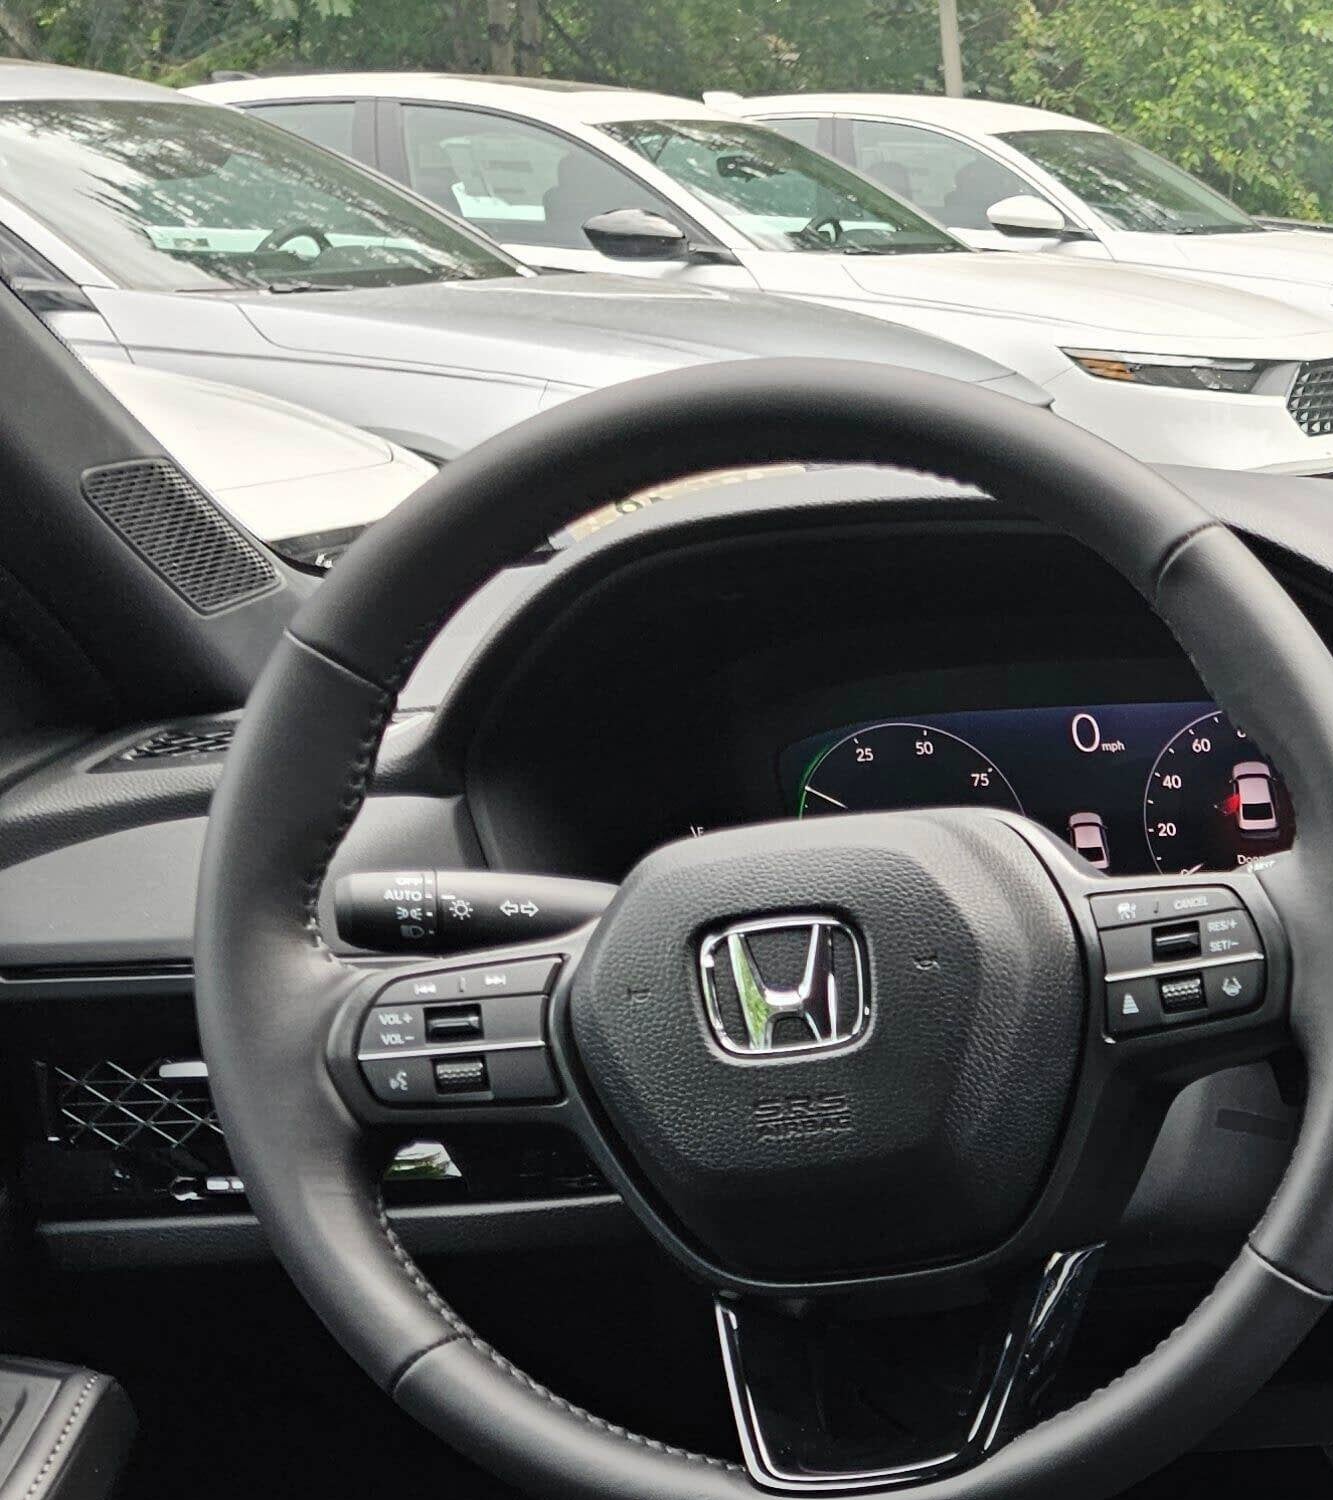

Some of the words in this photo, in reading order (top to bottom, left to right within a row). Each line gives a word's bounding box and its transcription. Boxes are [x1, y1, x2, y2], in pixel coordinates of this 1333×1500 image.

[1072, 713, 1100, 752] 0
[1102, 740, 1125, 753] mph
[915, 742, 934, 755] 50
[1192, 738, 1211, 753] 60
[856, 748, 873, 762] 25
[971, 773, 990, 787] 75
[1163, 775, 1182, 789] 40
[1157, 823, 1177, 837] 20
[384, 889, 423, 901] AUTO
